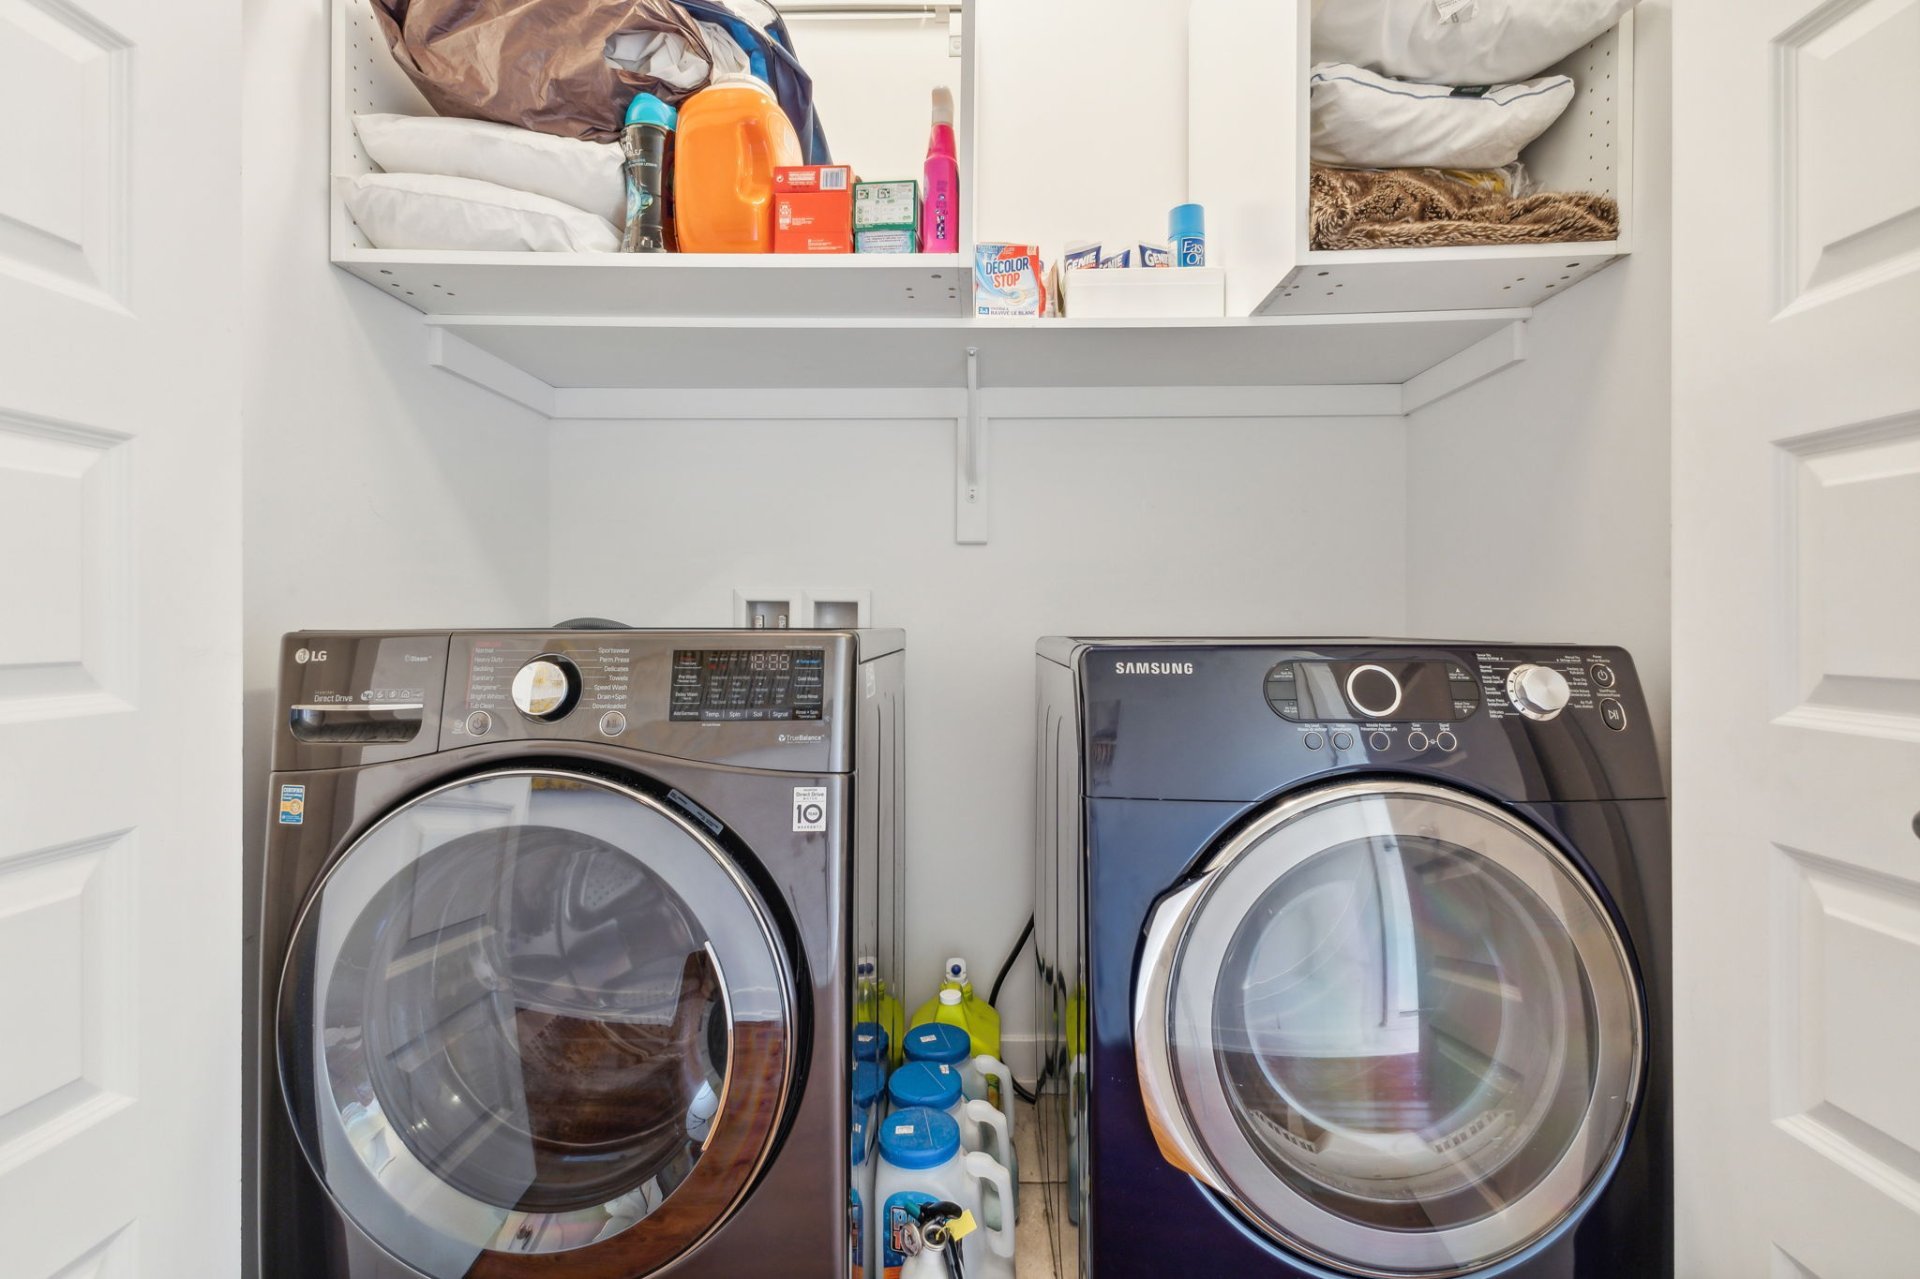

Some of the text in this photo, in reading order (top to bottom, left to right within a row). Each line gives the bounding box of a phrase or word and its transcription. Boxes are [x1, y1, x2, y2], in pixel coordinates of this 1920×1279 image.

[985, 256, 1030, 275] DÉCOLOR
[1187, 253, 1204, 266] On
[994, 272, 1021, 288] STOP
[311, 650, 328, 663] LG
[1115, 662, 1194, 675] SAMSUNG
[314, 694, 354, 702] Direct Drive
[797, 804, 823, 823] 10
